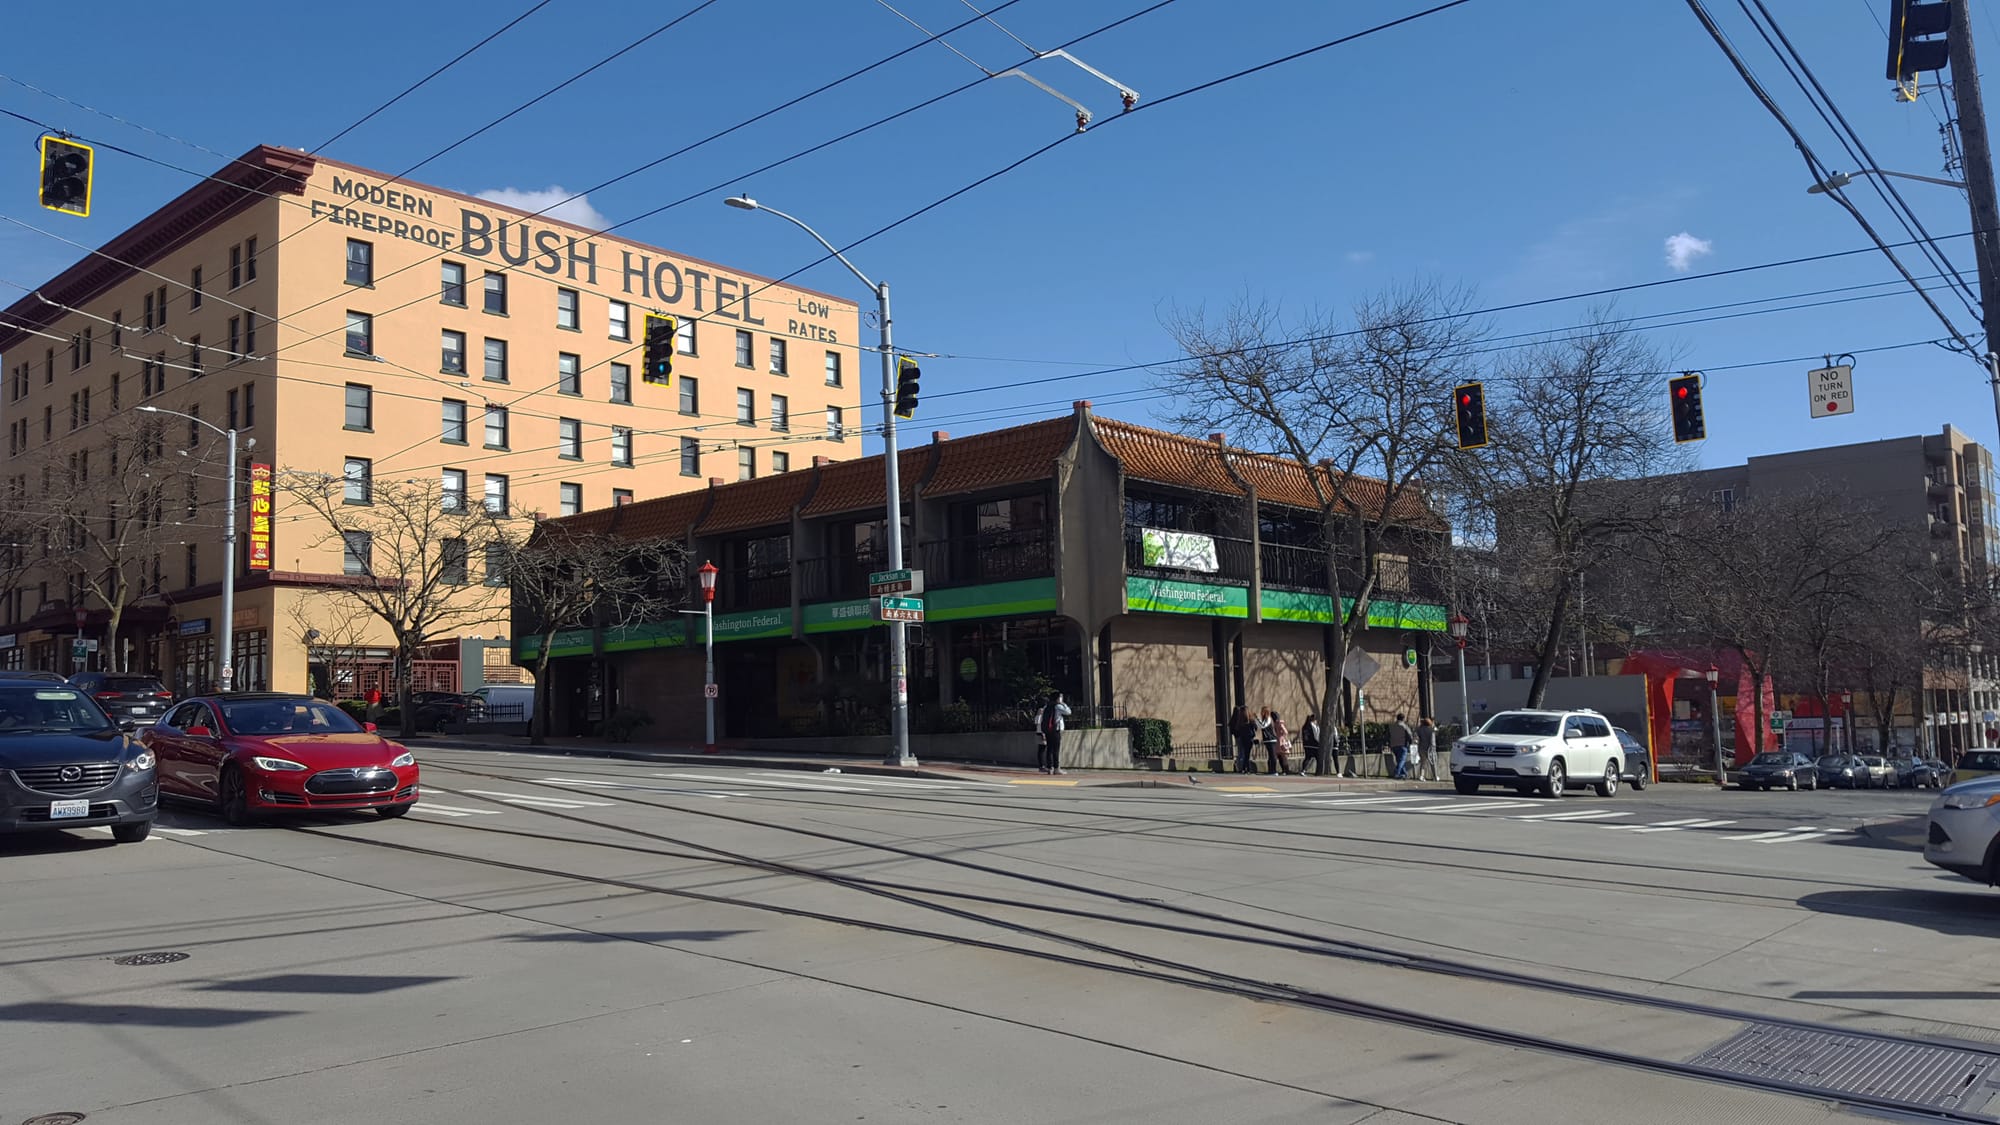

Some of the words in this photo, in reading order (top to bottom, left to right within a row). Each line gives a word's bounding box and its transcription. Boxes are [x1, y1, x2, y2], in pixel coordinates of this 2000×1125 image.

[333, 176, 433, 218] MODERN
[311, 199, 455, 249] FIREPROOF
[459, 208, 599, 285] BUSH
[621, 250, 765, 326] HOTEL
[797, 297, 830, 319] LOW
[788, 319, 837, 344] RATES
[1818, 381, 1843, 392] TURN
[1820, 370, 1839, 382] NO
[1814, 394, 1826, 403] ON
[1831, 390, 1849, 400] RED
[1149, 583, 1195, 602] Washington
